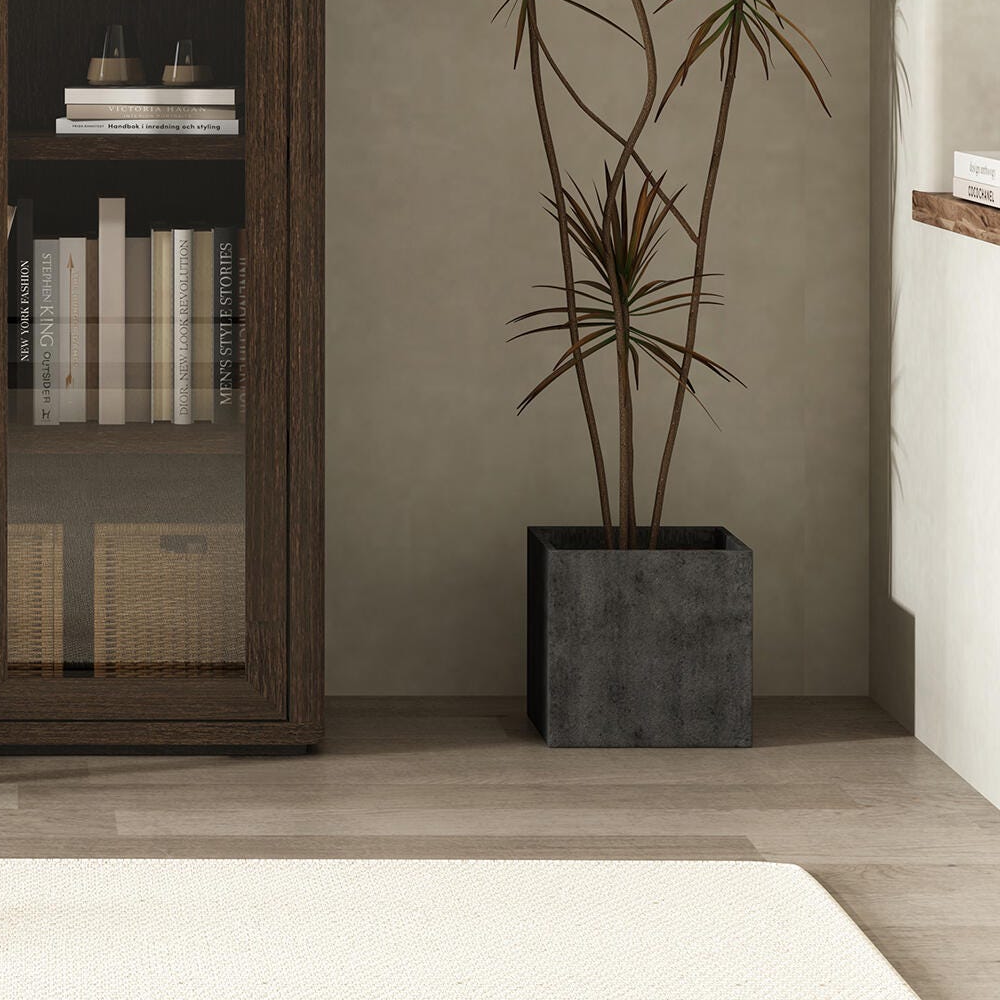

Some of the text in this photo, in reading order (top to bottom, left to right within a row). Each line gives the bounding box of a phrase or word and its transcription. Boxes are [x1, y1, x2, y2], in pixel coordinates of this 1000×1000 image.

[107, 105, 161, 113] VICTORIA
[145, 123, 180, 131] inredning
[197, 123, 221, 131] styling
[39, 252, 54, 348] STEPHEN KING
[179, 239, 190, 315] REVOLUTION
[20, 260, 30, 362] NEW YORK FASHION
[179, 319, 190, 350] LOOK
[219, 242, 233, 405] MEN'S STYLE STORIES
[41, 351, 52, 404] OUTSIDER
[179, 354, 190, 381] NEW
